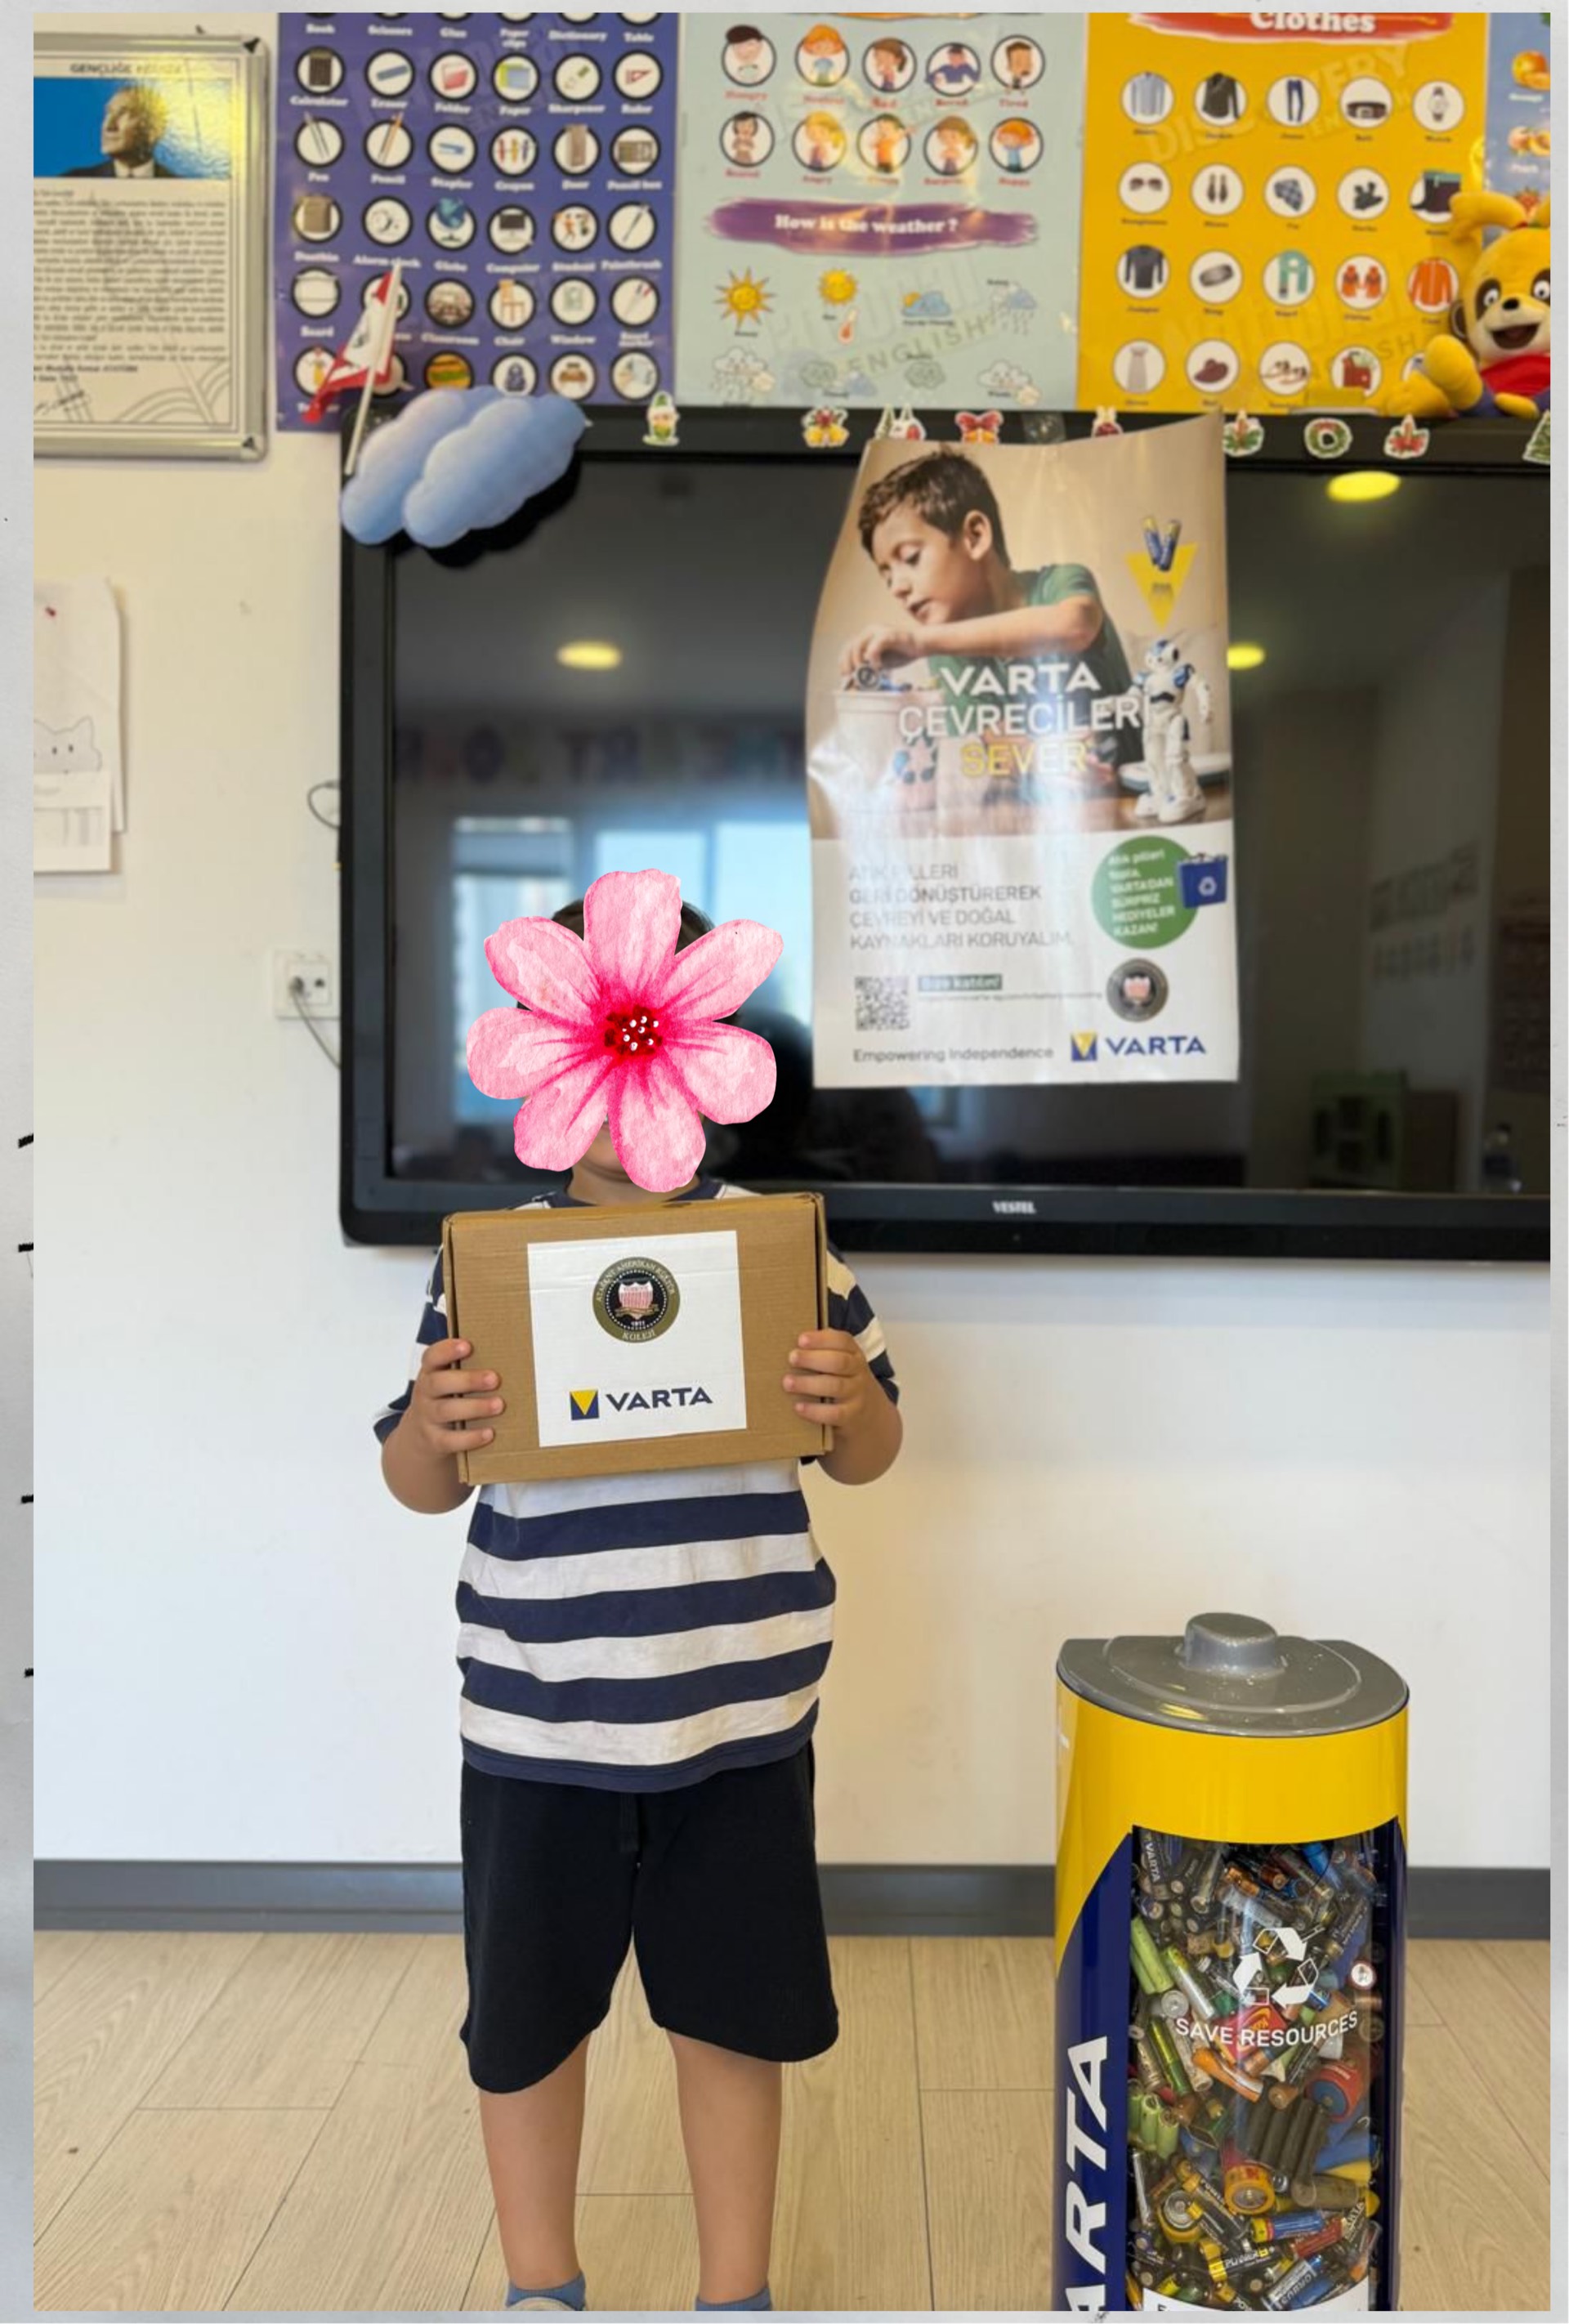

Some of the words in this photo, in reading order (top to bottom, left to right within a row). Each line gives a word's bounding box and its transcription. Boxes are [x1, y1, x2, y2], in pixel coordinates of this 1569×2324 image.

[1249, 11, 1376, 33] Clothes
[548, 30, 607, 42] Dictionary
[623, 32, 654, 42] Table
[289, 96, 349, 107] Calculator
[308, 172, 329, 182] Pen
[370, 173, 406, 185] Pencil
[774, 214, 816, 230] How
[820, 217, 834, 230] is
[838, 217, 868, 232] the
[871, 218, 945, 234] weather
[300, 325, 334, 337] Board
[550, 334, 597, 345] Window
[939, 661, 1102, 696] VARTA
[960, 740, 1088, 776] SEVER
[930, 911, 952, 926] VE
[955, 908, 1016, 925] DOĞAL
[853, 1048, 946, 1063] Empowering
[949, 1046, 1054, 1061] Independence
[1105, 1035, 1206, 1056] VARTA
[606, 1387, 713, 1413] VARTA
[1146, 1842, 1161, 1883] VARTA
[1175, 2017, 1234, 2045] SAVE
[1240, 2011, 1358, 2048] RESOURCES
[1065, 2036, 1108, 2312] RTA
